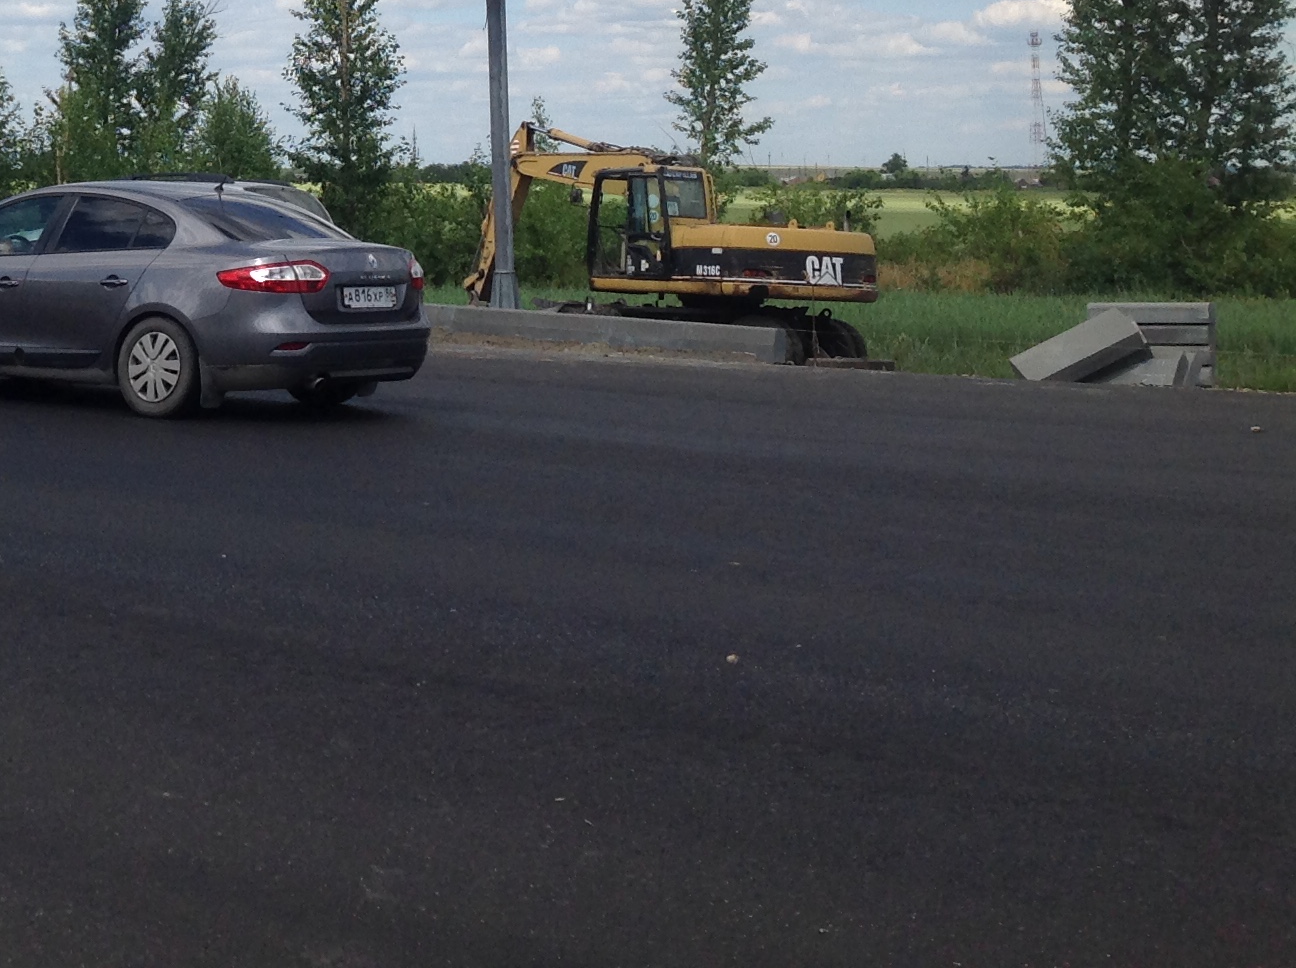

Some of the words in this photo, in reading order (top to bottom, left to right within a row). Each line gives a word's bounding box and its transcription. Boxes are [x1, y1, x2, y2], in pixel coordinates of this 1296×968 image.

[563, 163, 576, 177] CAT
[768, 234, 778, 244] 20
[806, 255, 844, 286] CAT
